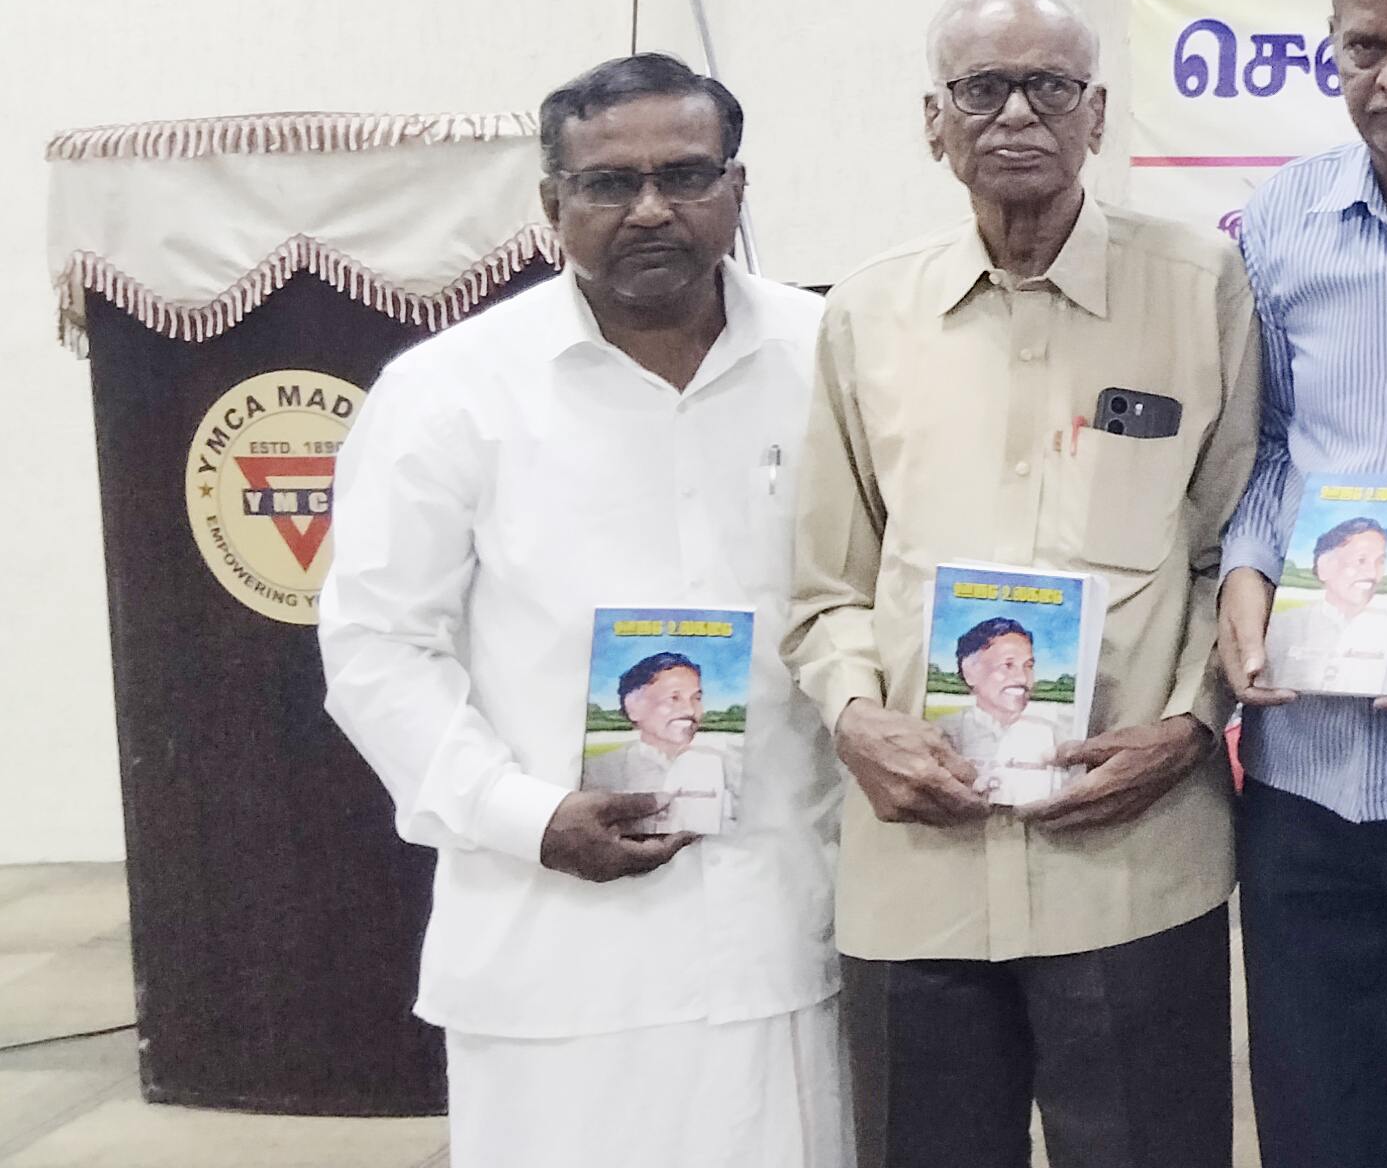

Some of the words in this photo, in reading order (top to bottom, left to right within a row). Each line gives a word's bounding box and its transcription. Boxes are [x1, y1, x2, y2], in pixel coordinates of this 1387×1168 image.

[198, 395, 266, 475] YMCA
[276, 385, 354, 419] MAD
[250, 441, 297, 455] ESTD.
[246, 490, 331, 514] YMC
[206, 515, 299, 608] EMPOWERING
